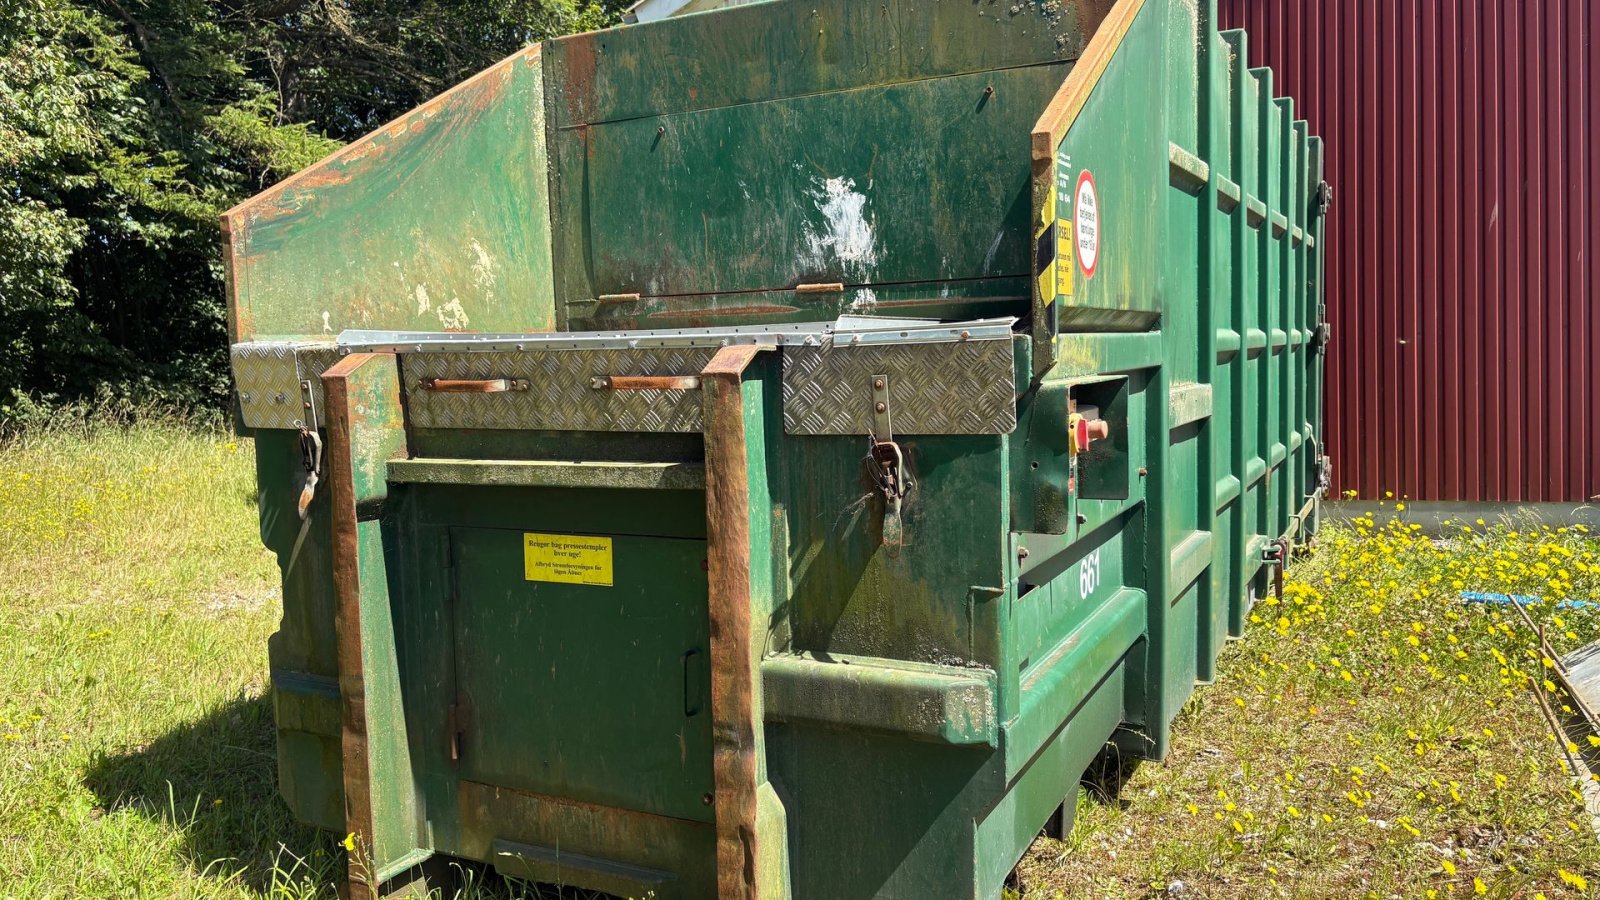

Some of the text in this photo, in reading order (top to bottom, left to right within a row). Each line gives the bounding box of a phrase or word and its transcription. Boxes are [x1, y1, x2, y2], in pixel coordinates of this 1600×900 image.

[551, 541, 562, 550] bag
[568, 551, 581, 559] uge!
[535, 561, 552, 569] Afbryd
[1080, 547, 1100, 600] 661
